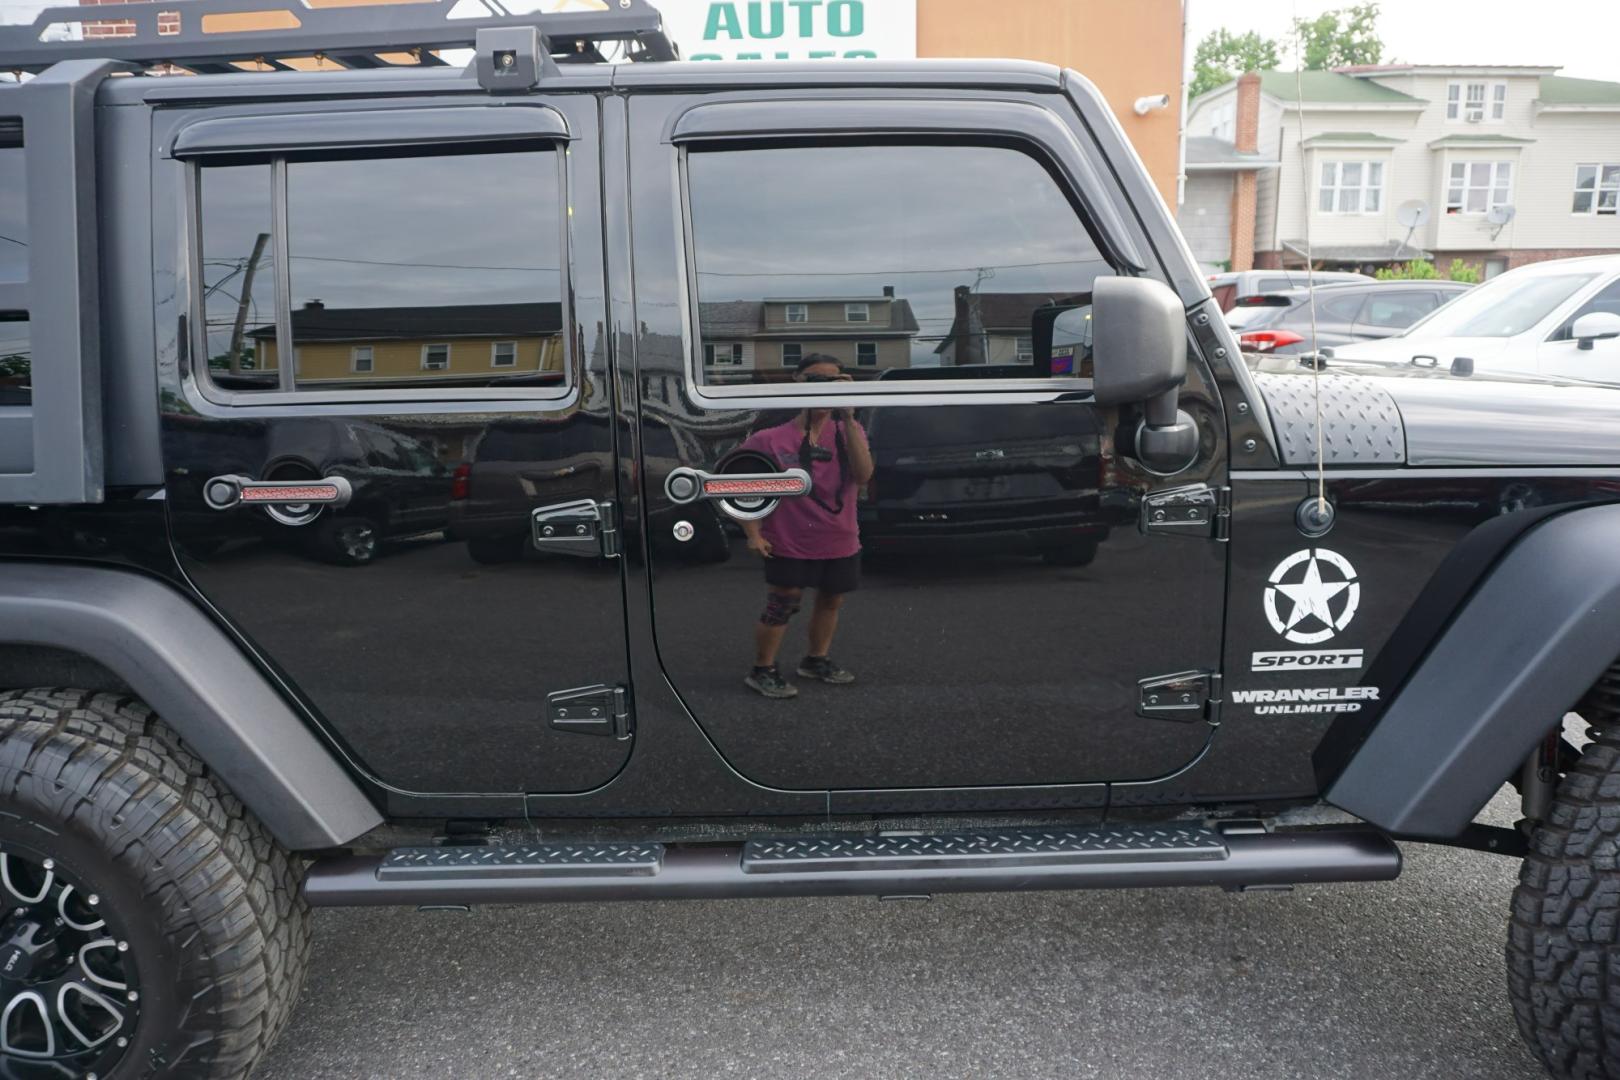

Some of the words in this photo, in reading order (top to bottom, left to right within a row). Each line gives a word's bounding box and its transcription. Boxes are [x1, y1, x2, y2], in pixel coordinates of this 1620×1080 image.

[703, 0, 864, 40] AUTO
[1254, 652, 1361, 667] SPORT
[1232, 686, 1380, 703] WRANGLER
[1254, 703, 1361, 715] UNLIMITED
